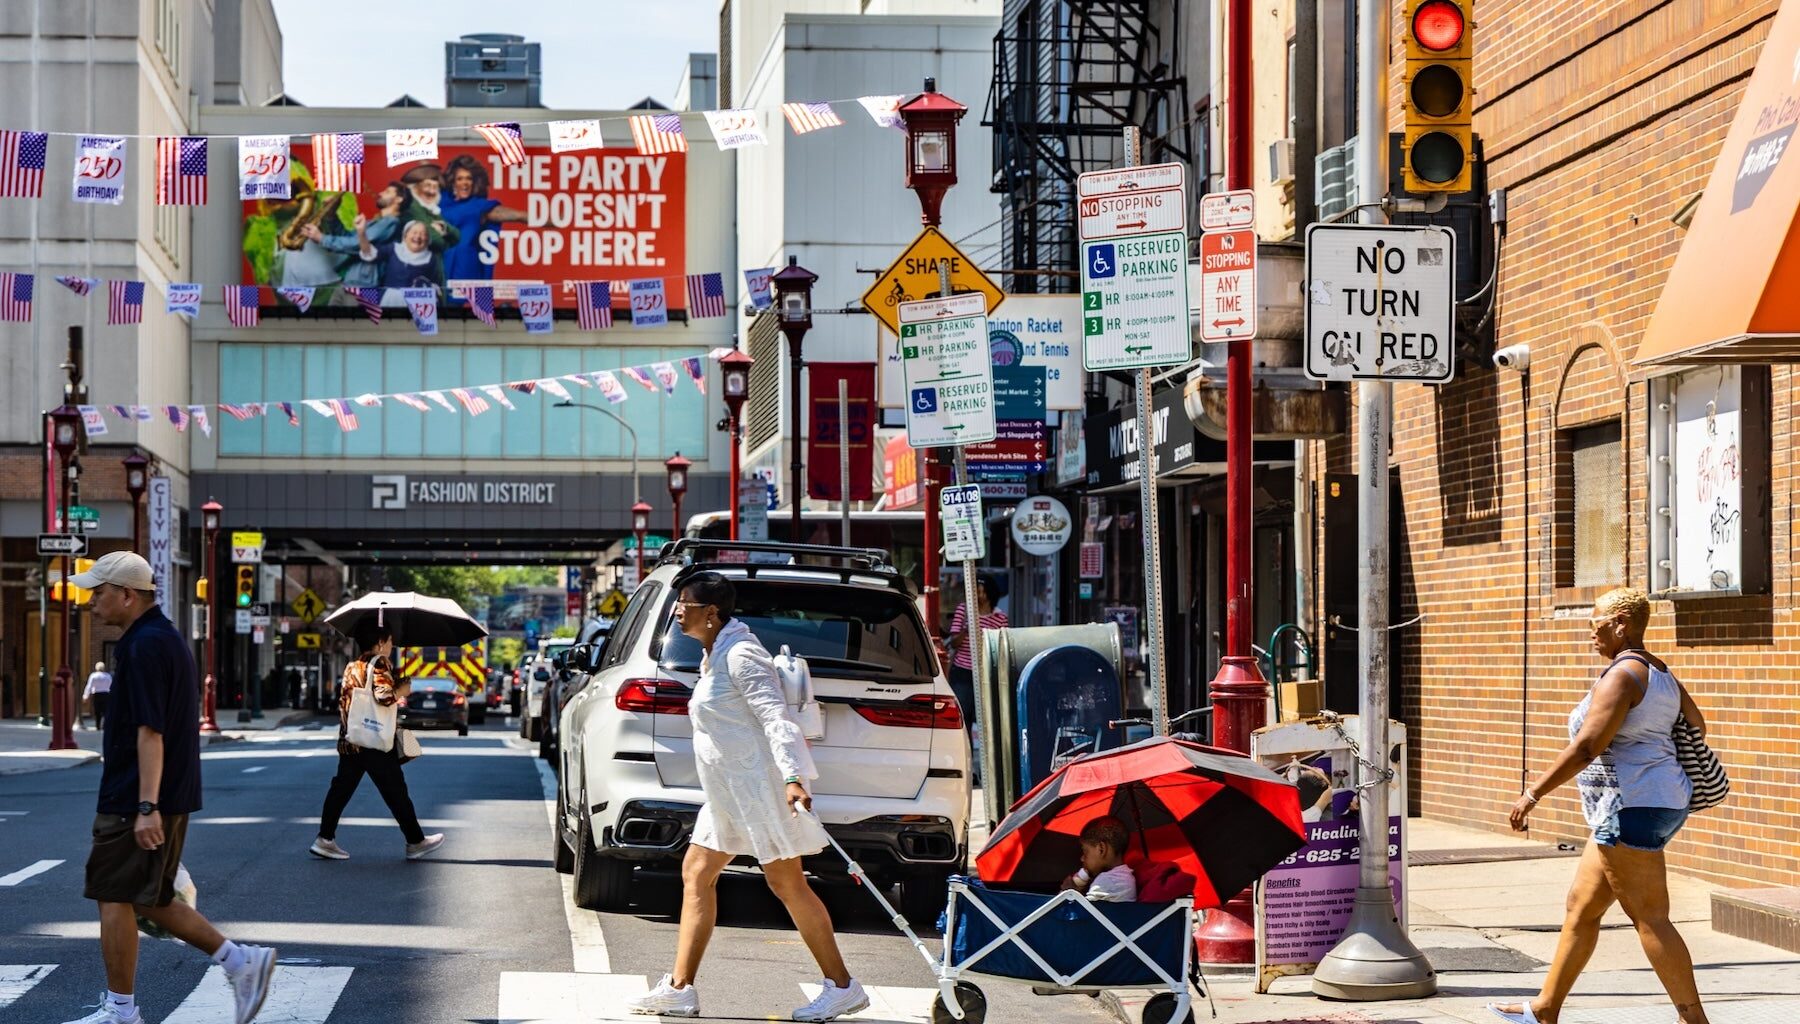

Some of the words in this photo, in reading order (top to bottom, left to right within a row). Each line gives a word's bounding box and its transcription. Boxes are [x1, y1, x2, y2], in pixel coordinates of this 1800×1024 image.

[79, 156, 122, 179] 250
[244, 155, 287, 175] 250
[488, 154, 552, 190] THE
[558, 154, 668, 191] PARTY
[77, 186, 119, 199] BIRTHDAY!
[245, 182, 286, 195] BIRTHDAY!
[527, 192, 667, 229] DOESN'T
[1081, 202, 1099, 217] NO
[1101, 195, 1162, 213] STOPPING
[1116, 213, 1130, 221] ANY
[1132, 211, 1147, 220] TIME
[478, 229, 565, 266] STOP
[569, 230, 667, 267] HERE.
[1118, 238, 1180, 258] RESERVED
[1221, 235, 1235, 250] NO
[1122, 258, 1178, 277] PARKING
[1205, 251, 1251, 269] STOPPING
[1356, 246, 1406, 275] NO
[1216, 275, 1240, 294] ANY
[633, 293, 664, 311] 250
[1089, 294, 1097, 308] 2
[1105, 292, 1120, 306] HR
[1125, 290, 1174, 302] 8:00AM-4:00PM
[1215, 295, 1242, 313] TIME
[1342, 288, 1420, 317] TURN
[414, 302, 435, 318] 50
[520, 300, 551, 318] 250
[906, 326, 913, 336] 2
[919, 324, 933, 335] HR
[937, 319, 976, 333] PARKING
[1027, 317, 1063, 333] Racket
[1091, 319, 1098, 333] 3
[1106, 317, 1121, 331] HR
[1124, 331, 1150, 341] MON-SAT
[908, 347, 915, 358] 3
[921, 345, 934, 356] HR
[939, 340, 978, 354] PARKING
[1040, 341, 1070, 357] Tennis
[1380, 332, 1438, 361] RED
[938, 382, 988, 398] RESERVED
[943, 397, 987, 412] PARKING
[1006, 431, 1035, 439] Shopping
[998, 452, 1010, 460] Park
[1012, 452, 1028, 460] Sites
[410, 481, 478, 503] FASHION
[483, 482, 555, 504] DISTRICT
[943, 490, 979, 504] 914108
[153, 482, 166, 532] CITY
[55, 540, 72, 549] WAY
[1266, 877, 1302, 889] Benefits
[1311, 888, 1326, 897] Blood
[1303, 909, 1326, 918] Thinning
[1284, 921, 1299, 929] Itchy
[1304, 920, 1315, 928] Oily
[1315, 919, 1331, 927] Scalp
